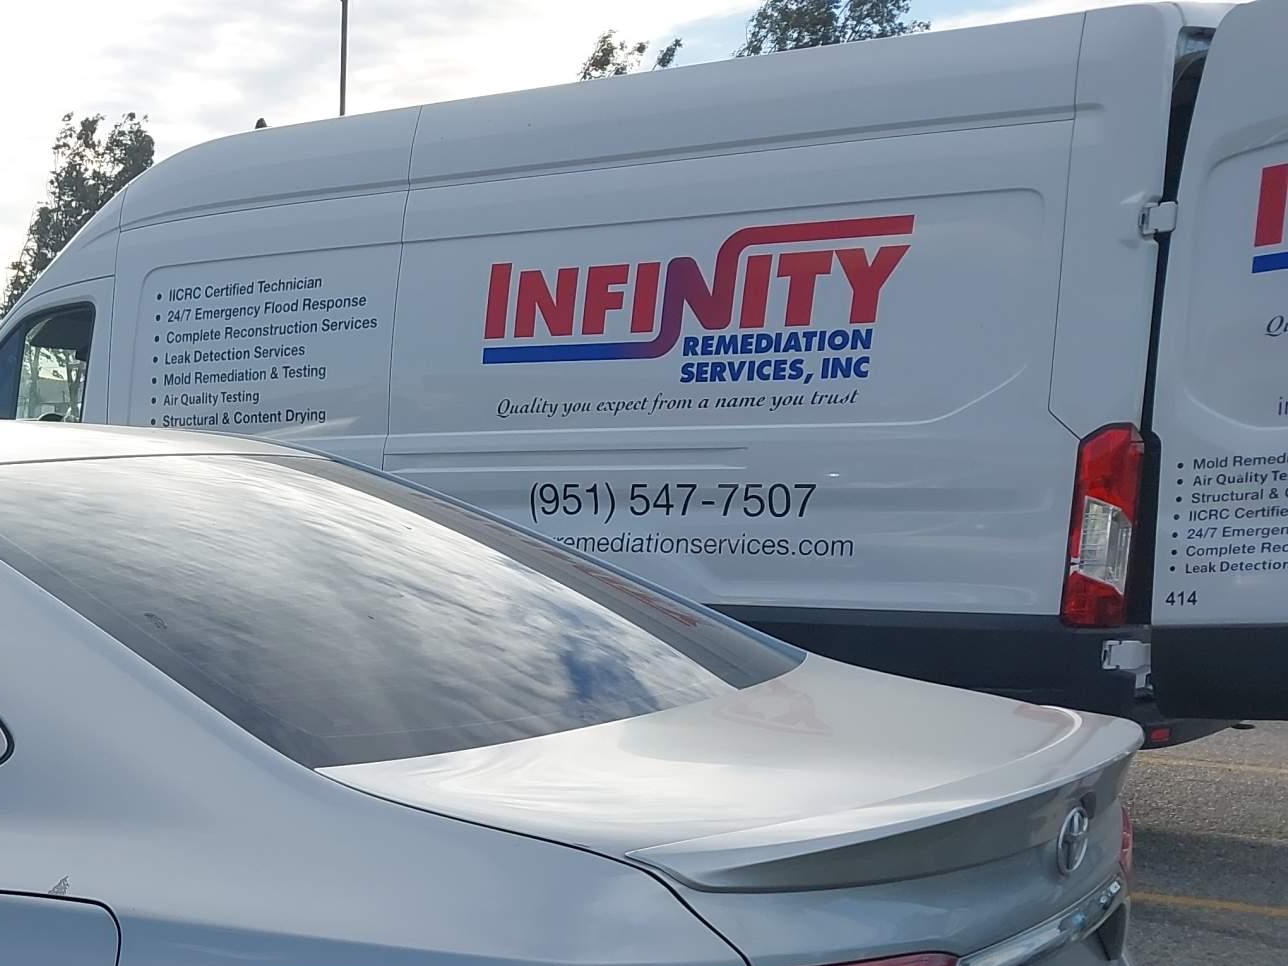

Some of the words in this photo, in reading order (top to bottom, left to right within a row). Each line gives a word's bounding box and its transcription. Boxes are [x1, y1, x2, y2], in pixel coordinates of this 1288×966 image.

[169, 287, 202, 302] IICRC
[205, 281, 255, 299] Certified
[257, 276, 322, 294] Technician
[483, 214, 915, 364] INFINITY
[167, 308, 192, 322] 24/7
[195, 305, 261, 321] Emergency
[264, 297, 299, 315] Flood
[302, 295, 367, 312] Response
[166, 328, 221, 344] Complete
[224, 319, 318, 340] Reconstruction
[321, 316, 378, 332] Services
[683, 328, 873, 357] REMEDIATION
[165, 350, 191, 365] Leak
[194, 347, 250, 363] Detection
[253, 345, 306, 359] Services
[163, 371, 191, 386] Mold
[194, 368, 267, 385] Remediation
[270, 366, 279, 379] &
[283, 364, 327, 380] Testing
[679, 357, 814, 384] SERVICES,
[821, 356, 870, 379] INC
[163, 393, 178, 407] Air
[180, 392, 218, 407] Quality
[221, 389, 260, 405] Testing
[496, 397, 558, 418] Quality
[561, 401, 591, 418] you
[596, 397, 648, 416] expect
[648, 392, 692, 415] from
[698, 398, 709, 409] a
[714, 395, 766, 409] name
[769, 394, 803, 412] you
[810, 388, 859, 405] trust
[162, 413, 219, 428] Structural
[222, 412, 230, 425] &
[233, 410, 282, 425] Content
[285, 408, 327, 424] Drying
[1193, 456, 1228, 470] Mold
[1193, 475, 1213, 487] Air
[1216, 471, 1268, 486] Quality
[529, 481, 617, 523] (951)
[629, 483, 817, 518] 547-7507
[1191, 489, 1264, 504] Structural
[1269, 487, 1280, 499] &
[1188, 508, 1230, 522] IICRC
[1186, 527, 1218, 540] 24/7
[553, 532, 854, 557] emediationservices.com
[1186, 544, 1256, 557] Complete
[1185, 562, 1217, 574] Leak
[1165, 590, 1198, 606] 414
